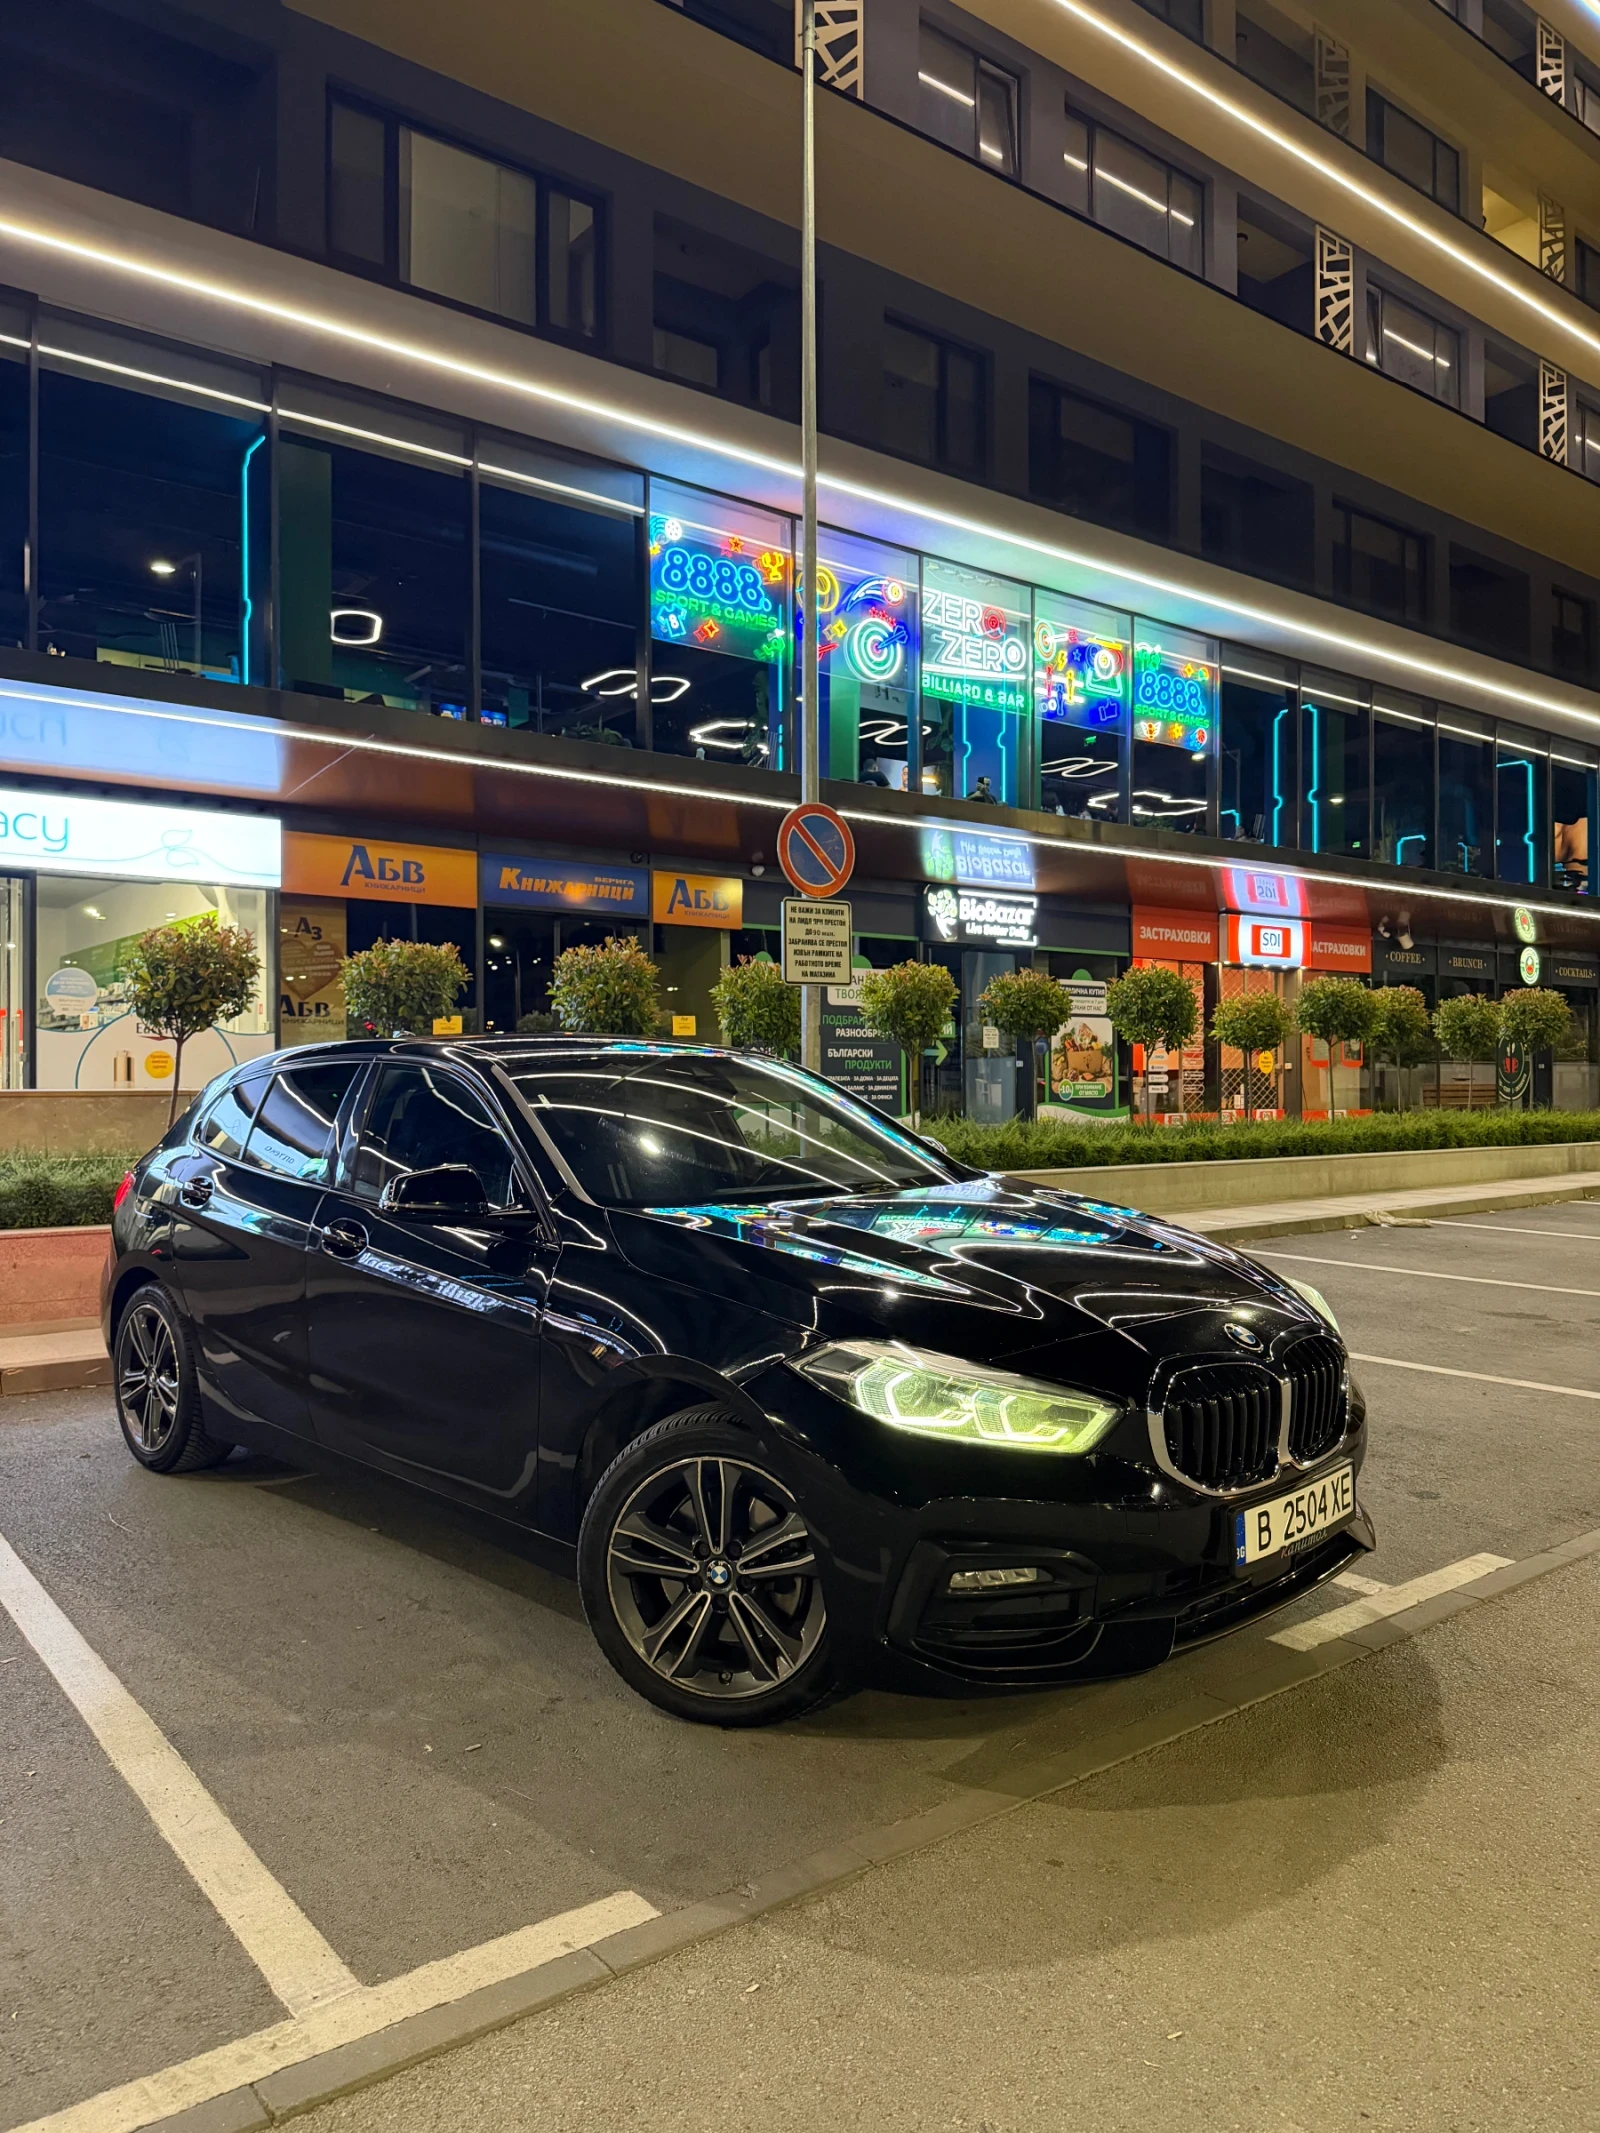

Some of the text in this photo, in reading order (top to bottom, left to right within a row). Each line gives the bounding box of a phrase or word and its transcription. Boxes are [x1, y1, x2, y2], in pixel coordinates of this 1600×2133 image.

[655, 589, 778, 629] SPORT & GAMES
[923, 590, 1006, 640] ZERO
[940, 633, 1026, 671] ZERO
[922, 674, 1024, 709] BILLIARD & BAR
[1134, 704, 1169, 718] SPORT
[1177, 713, 1210, 728] GAMES
[340, 844, 425, 886] АБВ
[364, 882, 426, 894] КНИЖАРНИЦИ
[594, 876, 635, 886] ВЕРИГА
[959, 898, 1035, 926] BioBazar
[1140, 925, 1211, 945] ЗАСТРАХОВКИ
[1312, 940, 1366, 956] АСТРАХОВКИ
[1390, 952, 1422, 964] COFFEE
[1452, 957, 1483, 969] BRUNCH
[1558, 968, 1592, 979] COCKTAILS
[822, 1014, 866, 1026] ПОДБРАН
[827, 1048, 874, 1058] БЪЛГАРСКИ
[844, 1060, 892, 1071] ПРОДУКТИ
[1258, 1472, 1351, 1552] B 2504 XE
